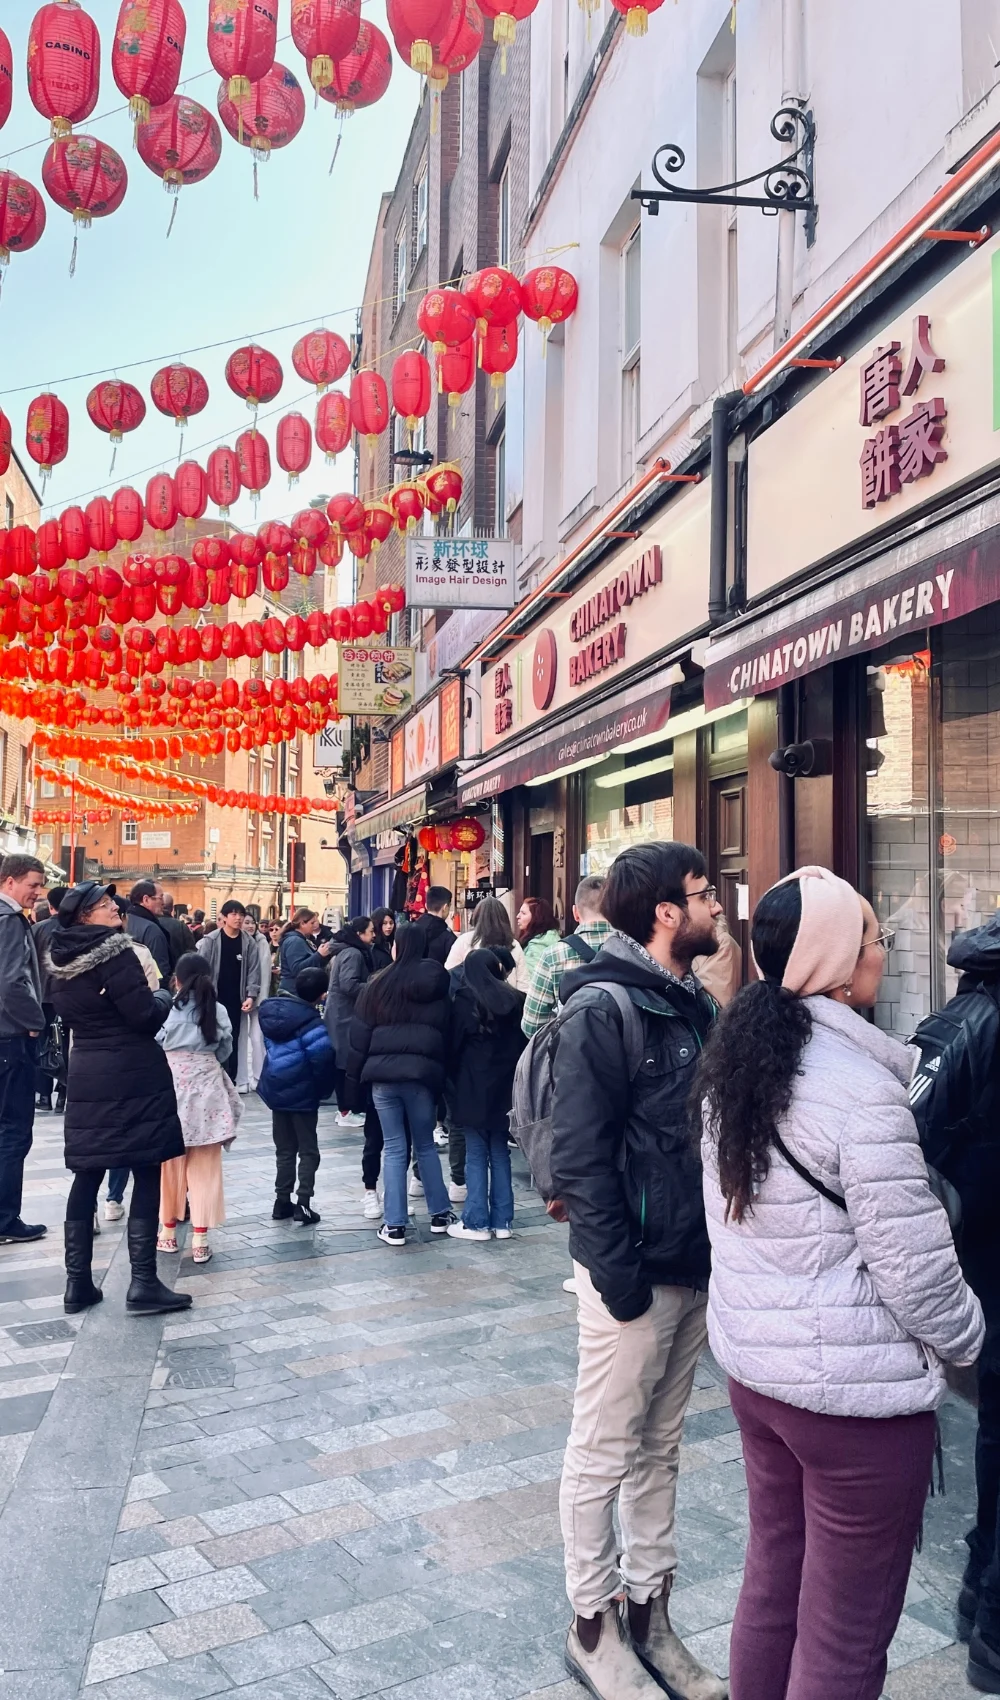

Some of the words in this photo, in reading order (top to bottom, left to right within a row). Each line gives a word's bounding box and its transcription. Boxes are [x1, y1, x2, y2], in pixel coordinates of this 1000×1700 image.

[45, 41, 91, 60] CASINO
[433, 540, 489, 559] 新环球
[415, 556, 506, 574] 形象發型設計
[415, 574, 446, 586] Image
[449, 575, 470, 585] Hair
[472, 575, 508, 587] Design
[569, 545, 663, 642] CHINATOWN
[730, 619, 843, 694] CHINATOWN
[848, 568, 955, 647] BAKERY
[569, 622, 627, 687] BAKERY
